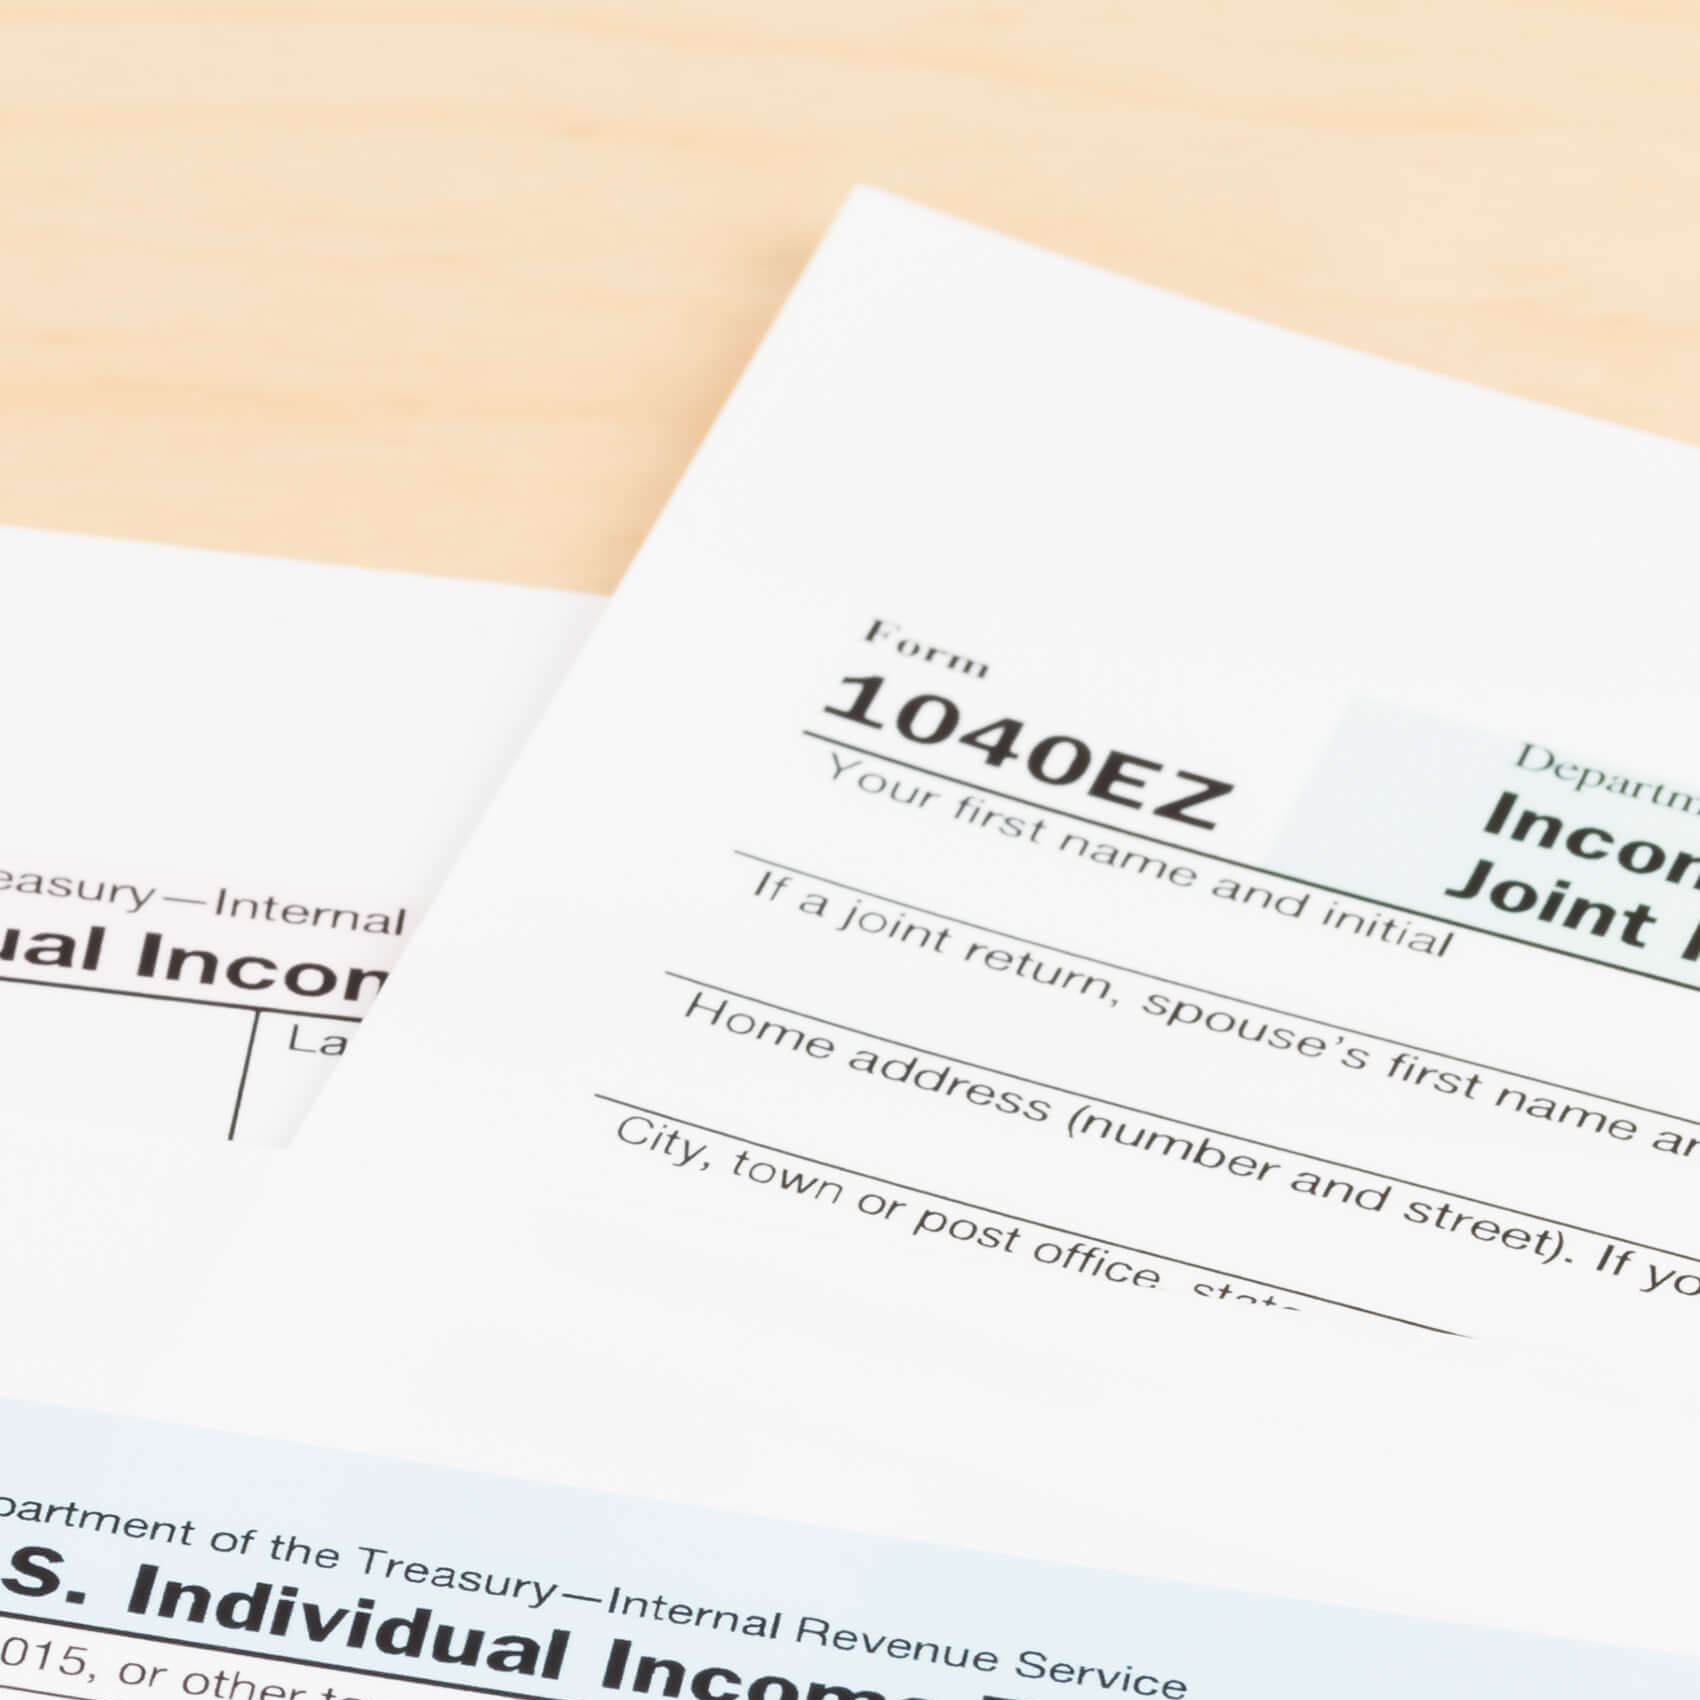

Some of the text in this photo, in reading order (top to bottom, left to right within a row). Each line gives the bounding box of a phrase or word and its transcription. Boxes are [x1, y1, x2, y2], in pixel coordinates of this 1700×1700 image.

[864, 618, 989, 679] Form
[823, 674, 1236, 832] 1040EZ
[831, 752, 1455, 958] Your first name and initial
[1443, 858, 1658, 950] Joint
[753, 871, 792, 901] If
[798, 893, 829, 918] a
[836, 905, 951, 953] joint
[964, 942, 1118, 1007] return,
[1387, 1052, 1483, 1100] first
[1495, 1087, 1638, 1141] name
[616, 1115, 711, 1172] City,
[732, 1150, 844, 1205] town
[857, 1193, 908, 1220] or
[912, 1208, 1022, 1254] post
[684, 991, 1636, 1276] Home address (number and street). If
[118, 1662, 169, 1688] or
[126, 1562, 572, 1681] Individual
[209, 1528, 259, 1555] of
[270, 1534, 340, 1569] the
[795, 1615, 999, 1673] Revenue
[1015, 1650, 1188, 1700] Service
